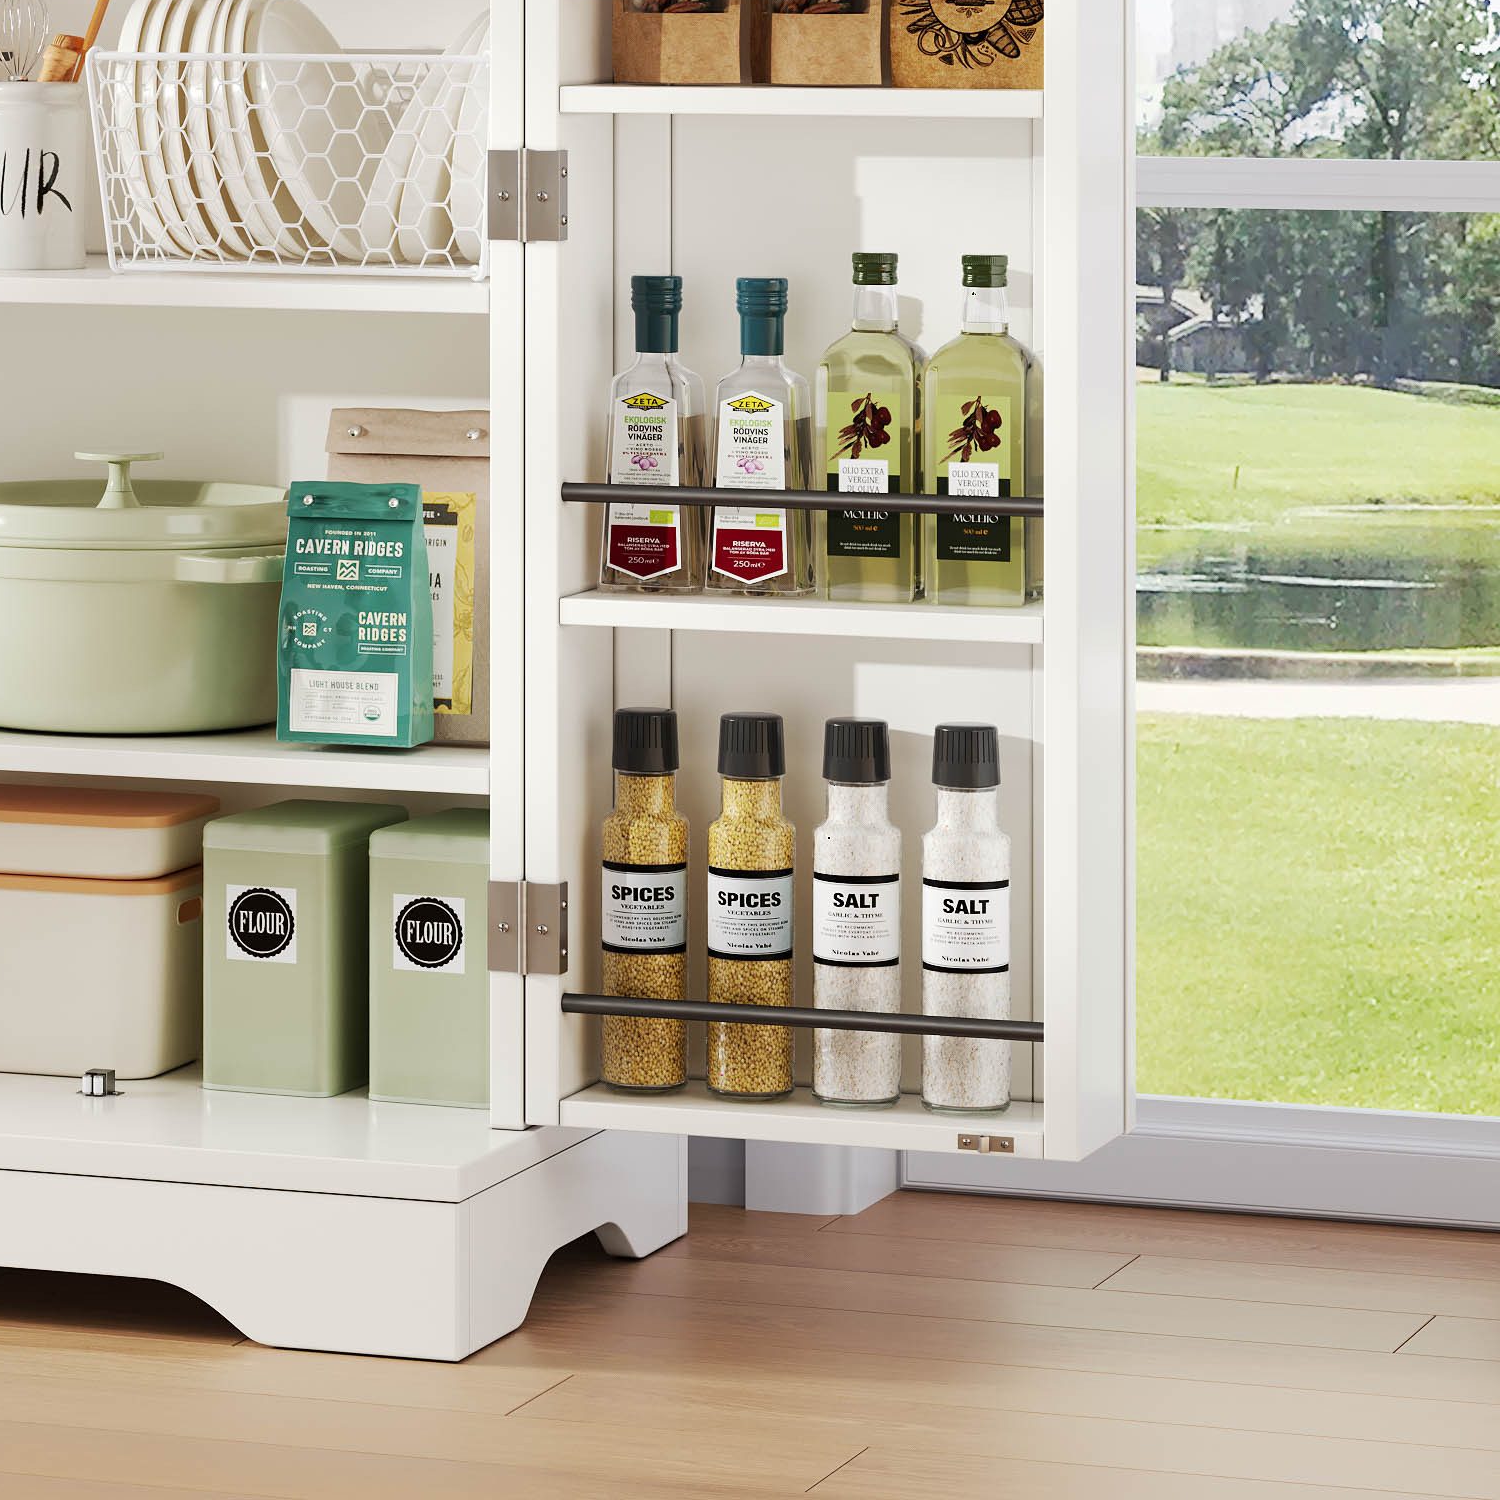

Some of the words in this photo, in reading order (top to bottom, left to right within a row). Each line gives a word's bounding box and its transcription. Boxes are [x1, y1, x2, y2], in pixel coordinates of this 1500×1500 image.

[624, 416, 666, 424] EKOLOGISK
[730, 419, 772, 427] EKOLOGISK
[848, 476, 879, 484] VERGINE
[952, 470, 969, 478] OLIO
[858, 485, 880, 493] OLIVA
[296, 539, 350, 555] CAVERN
[354, 541, 404, 558] RIDGES
[628, 556, 644, 564] 250
[293, 609, 327, 622] ROASTING
[358, 612, 407, 626] CAVERN
[358, 628, 407, 642] RIDGES
[294, 638, 326, 649] COMPANY
[309, 680, 328, 689] LIGHT
[331, 681, 354, 690] HOUSE
[356, 682, 379, 691] BLEND
[612, 885, 674, 902] SPICES
[718, 891, 781, 908] SPICES
[833, 892, 879, 908] SALT
[943, 899, 989, 914] SALT
[239, 910, 285, 935] FLOUR
[406, 920, 453, 945] FLOUR
